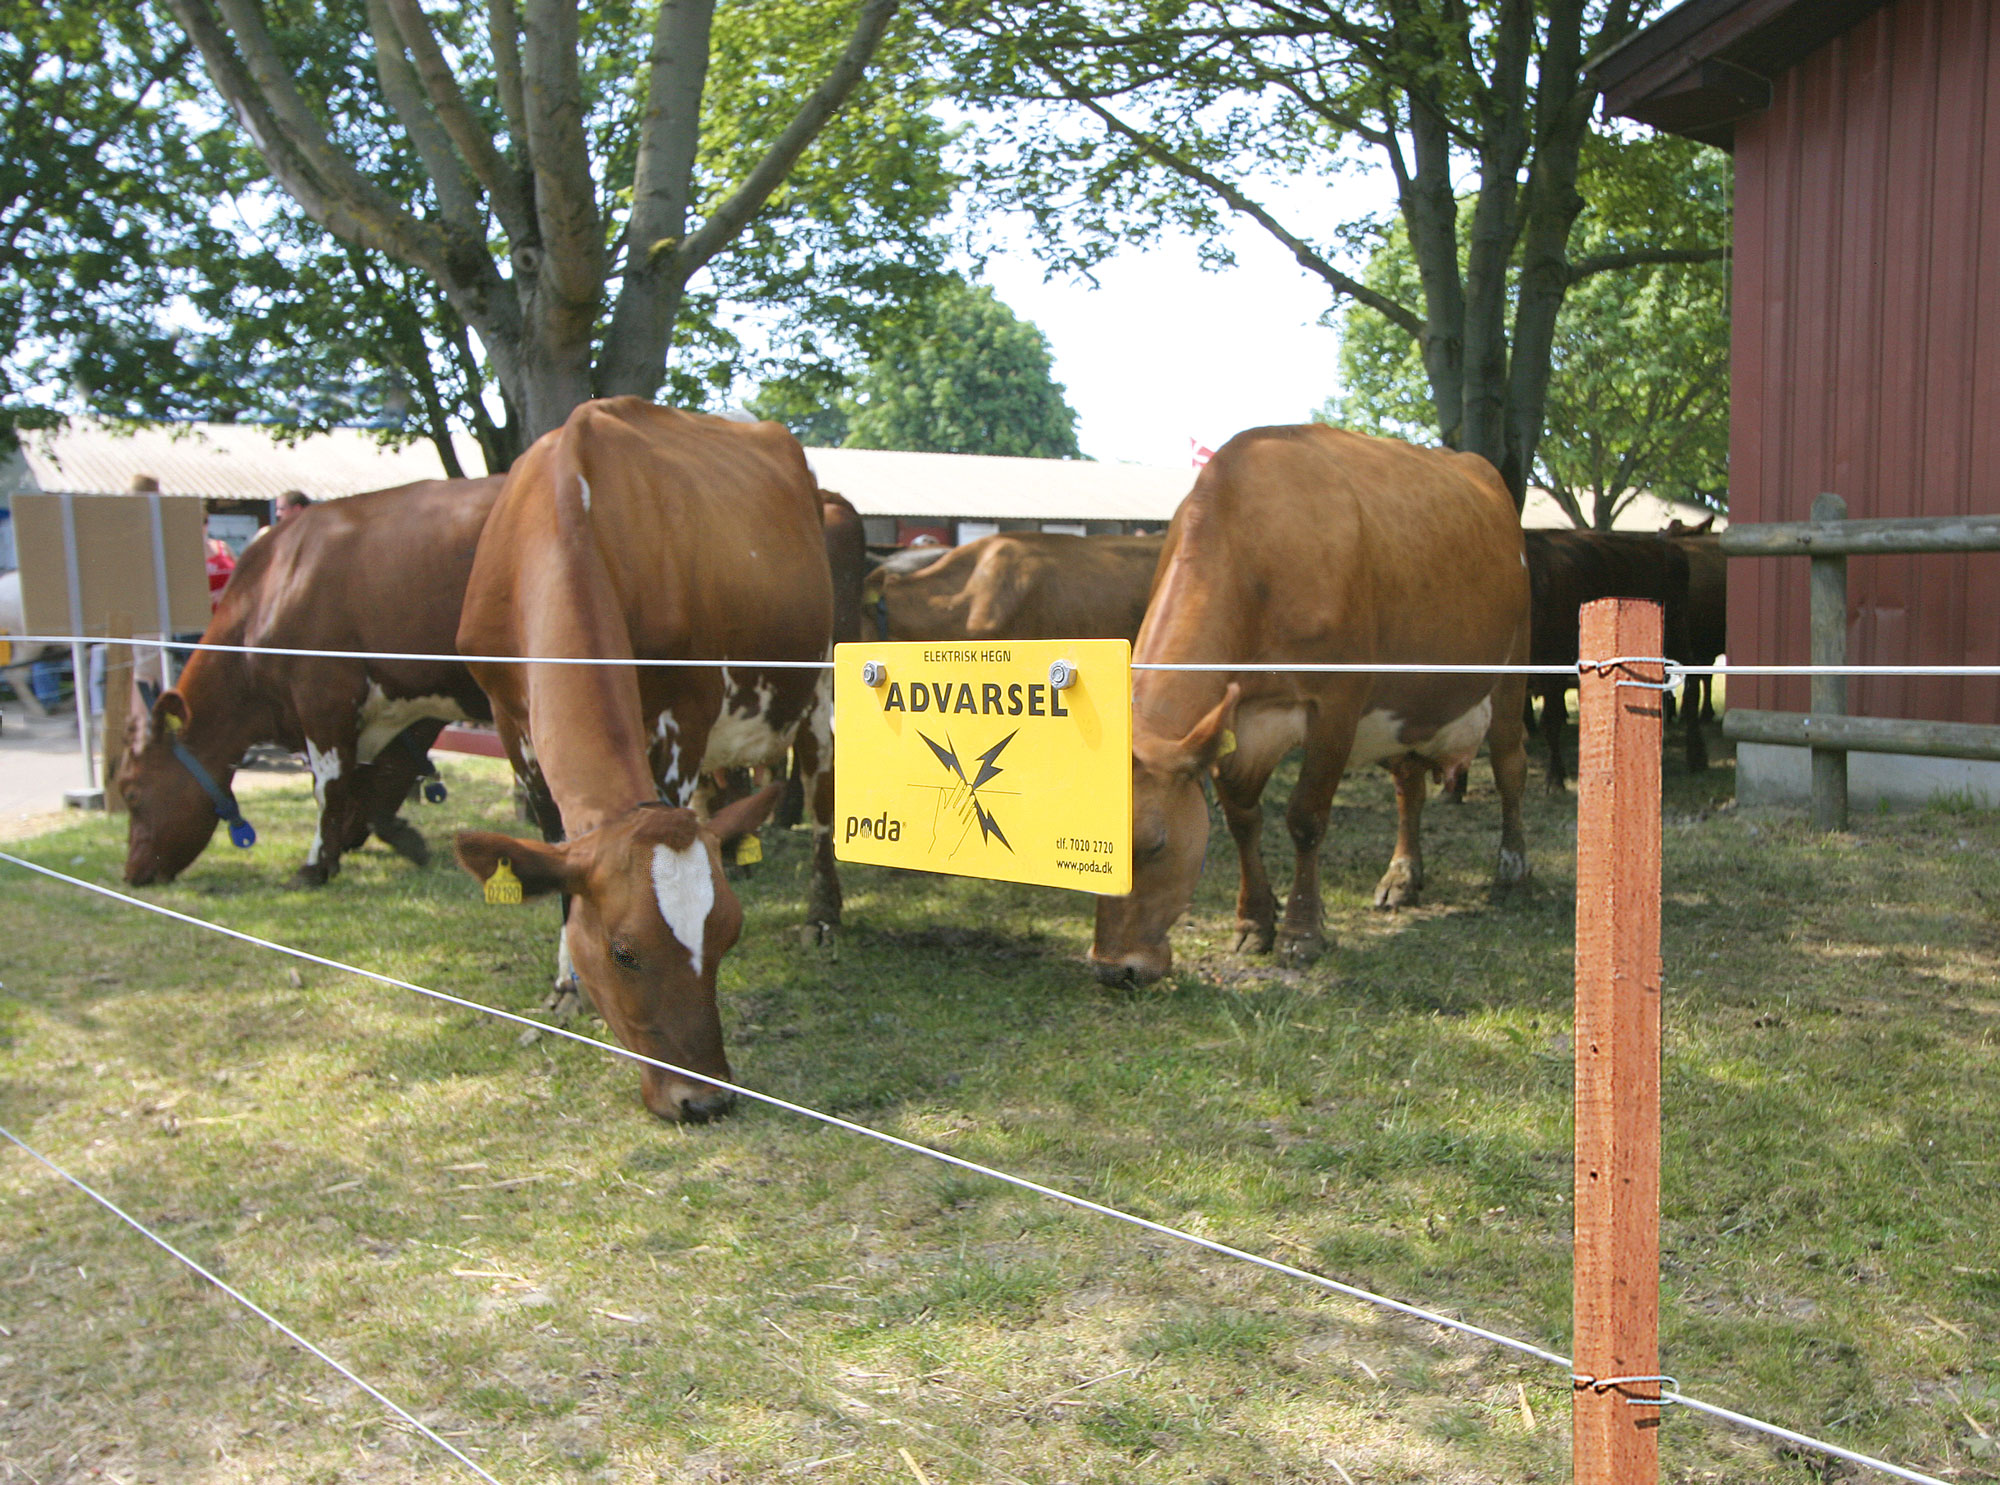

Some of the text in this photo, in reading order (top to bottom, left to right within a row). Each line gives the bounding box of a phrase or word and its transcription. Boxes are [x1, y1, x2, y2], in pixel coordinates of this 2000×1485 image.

[924, 650, 1011, 662] ELEKTRISK HEGN
[884, 682, 1068, 717] ADVARSEL
[1056, 837, 1113, 854] tlf. 7020 2720
[1056, 860, 1113, 875] www.poda.dk
